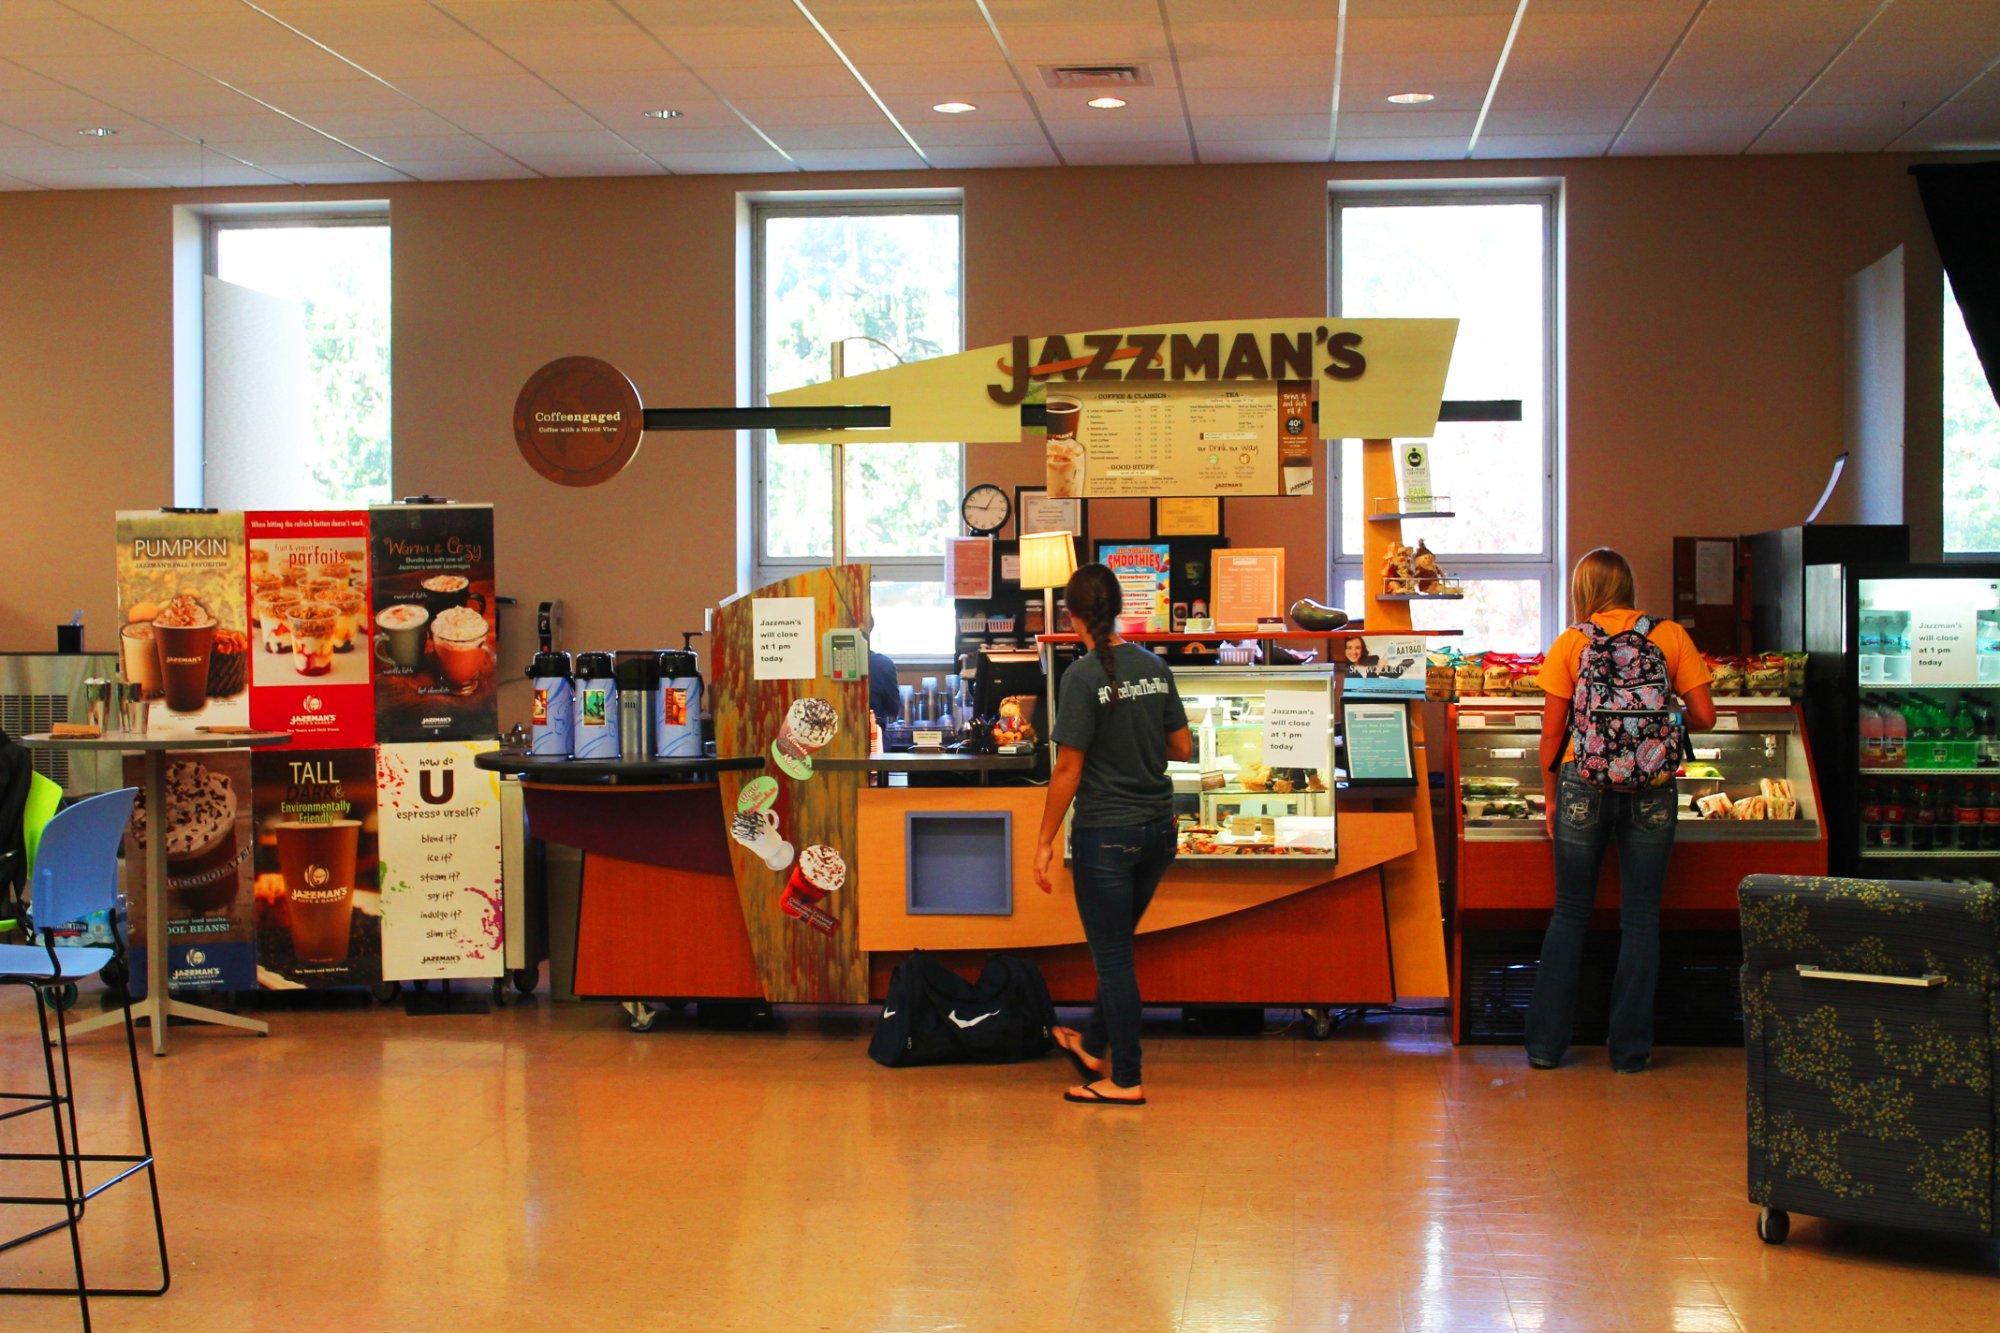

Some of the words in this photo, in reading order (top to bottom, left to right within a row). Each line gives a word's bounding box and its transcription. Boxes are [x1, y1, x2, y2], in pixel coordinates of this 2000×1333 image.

[986, 325, 1367, 405] JAZZMAN'S
[535, 411, 621, 424] Coffeengaged
[267, 521, 284, 529] hitting
[294, 520, 313, 528] refresh
[331, 519, 350, 527] doesn't
[135, 539, 227, 557] PUMPKIN
[447, 536, 482, 562] Cozy
[289, 546, 346, 568] parfaits
[1107, 554, 1160, 571] SMOOTHIES
[289, 714, 337, 725] JAZZMAN'S
[419, 758, 439, 766] how
[442, 757, 453, 765] do
[288, 761, 340, 784] TALL
[335, 785, 344, 799] &
[419, 769, 454, 805] U
[281, 800, 351, 814] Environmentally
[396, 808, 441, 821] espresso
[443, 806, 481, 818] urself?
[299, 812, 333, 824] Friendly
[421, 834, 444, 843] blend
[445, 833, 458, 843] it?
[426, 853, 439, 862] ice
[440, 853, 453, 862] it?
[420, 872, 447, 882] steam
[447, 871, 461, 881] it?
[291, 886, 348, 901] JAZZMAN'S
[427, 892, 441, 901] soy
[442, 891, 454, 900] it?
[420, 910, 448, 919] indulge
[449, 909, 463, 919] it?
[189, 923, 230, 933] BEANS!
[426, 930, 444, 938] slim
[445, 929, 458, 939] it?
[421, 955, 461, 964] JAZZMAN'S
[172, 967, 220, 980] JAZZMAN'S
